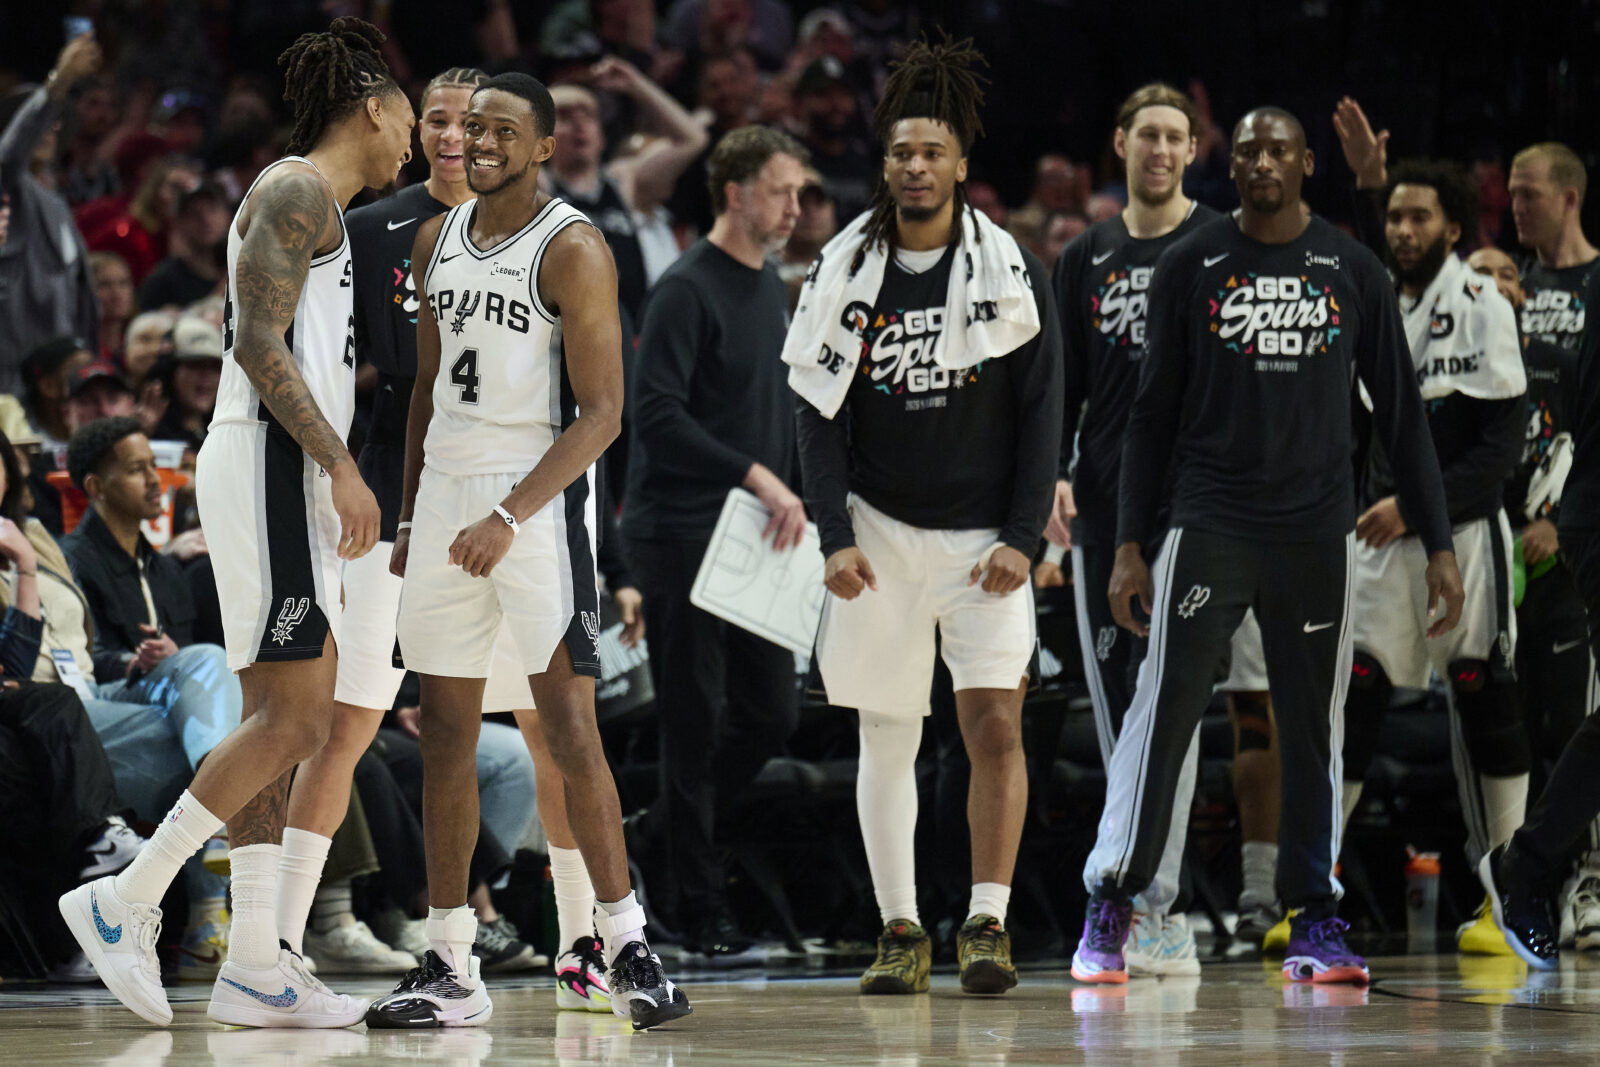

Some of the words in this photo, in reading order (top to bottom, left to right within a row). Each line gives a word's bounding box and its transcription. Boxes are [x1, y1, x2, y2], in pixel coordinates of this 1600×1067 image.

[495, 266, 520, 278] LEDGER
[1130, 267, 1155, 291] G
[1256, 276, 1301, 300] GO
[904, 306, 945, 336] GO
[1219, 285, 1328, 344] Spurs
[1258, 331, 1302, 356] GO
[449, 346, 482, 406] 4
[906, 366, 950, 393] GO
